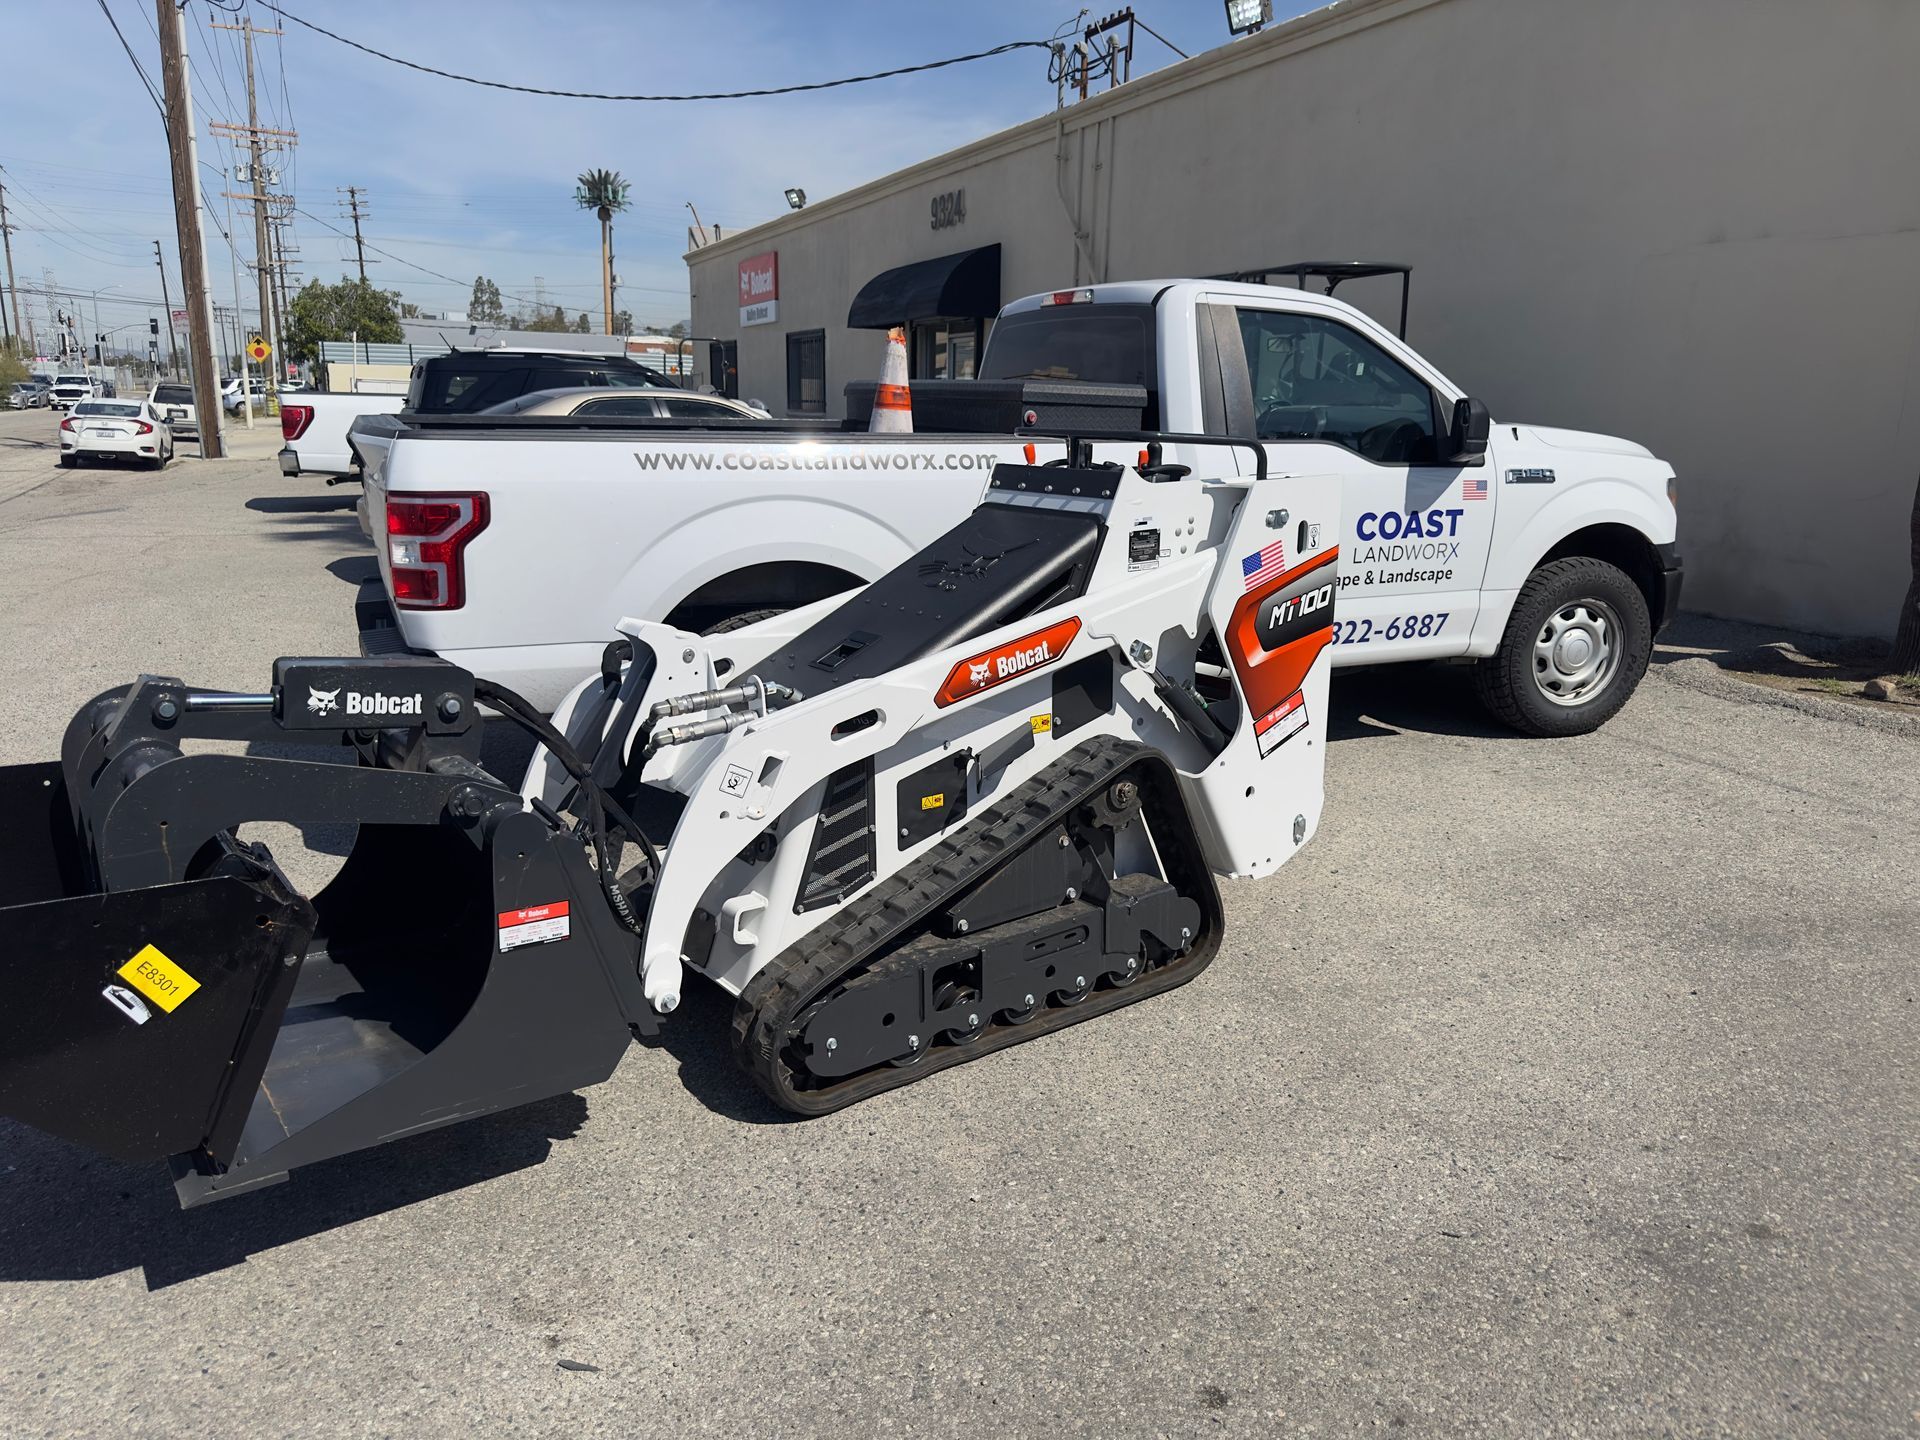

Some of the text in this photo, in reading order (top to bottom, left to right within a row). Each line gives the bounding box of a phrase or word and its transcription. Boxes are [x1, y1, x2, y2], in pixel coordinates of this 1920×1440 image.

[930, 189, 964, 230] 9324
[1356, 509, 1464, 541] COAST
[1353, 542, 1460, 565] LANDWORX
[1364, 570, 1375, 585] &
[1379, 568, 1453, 584] Landscape
[1268, 583, 1333, 630] MT100
[996, 640, 1050, 678] Bobcat
[346, 692, 423, 715] Bobcat
[136, 960, 180, 996] E8301
